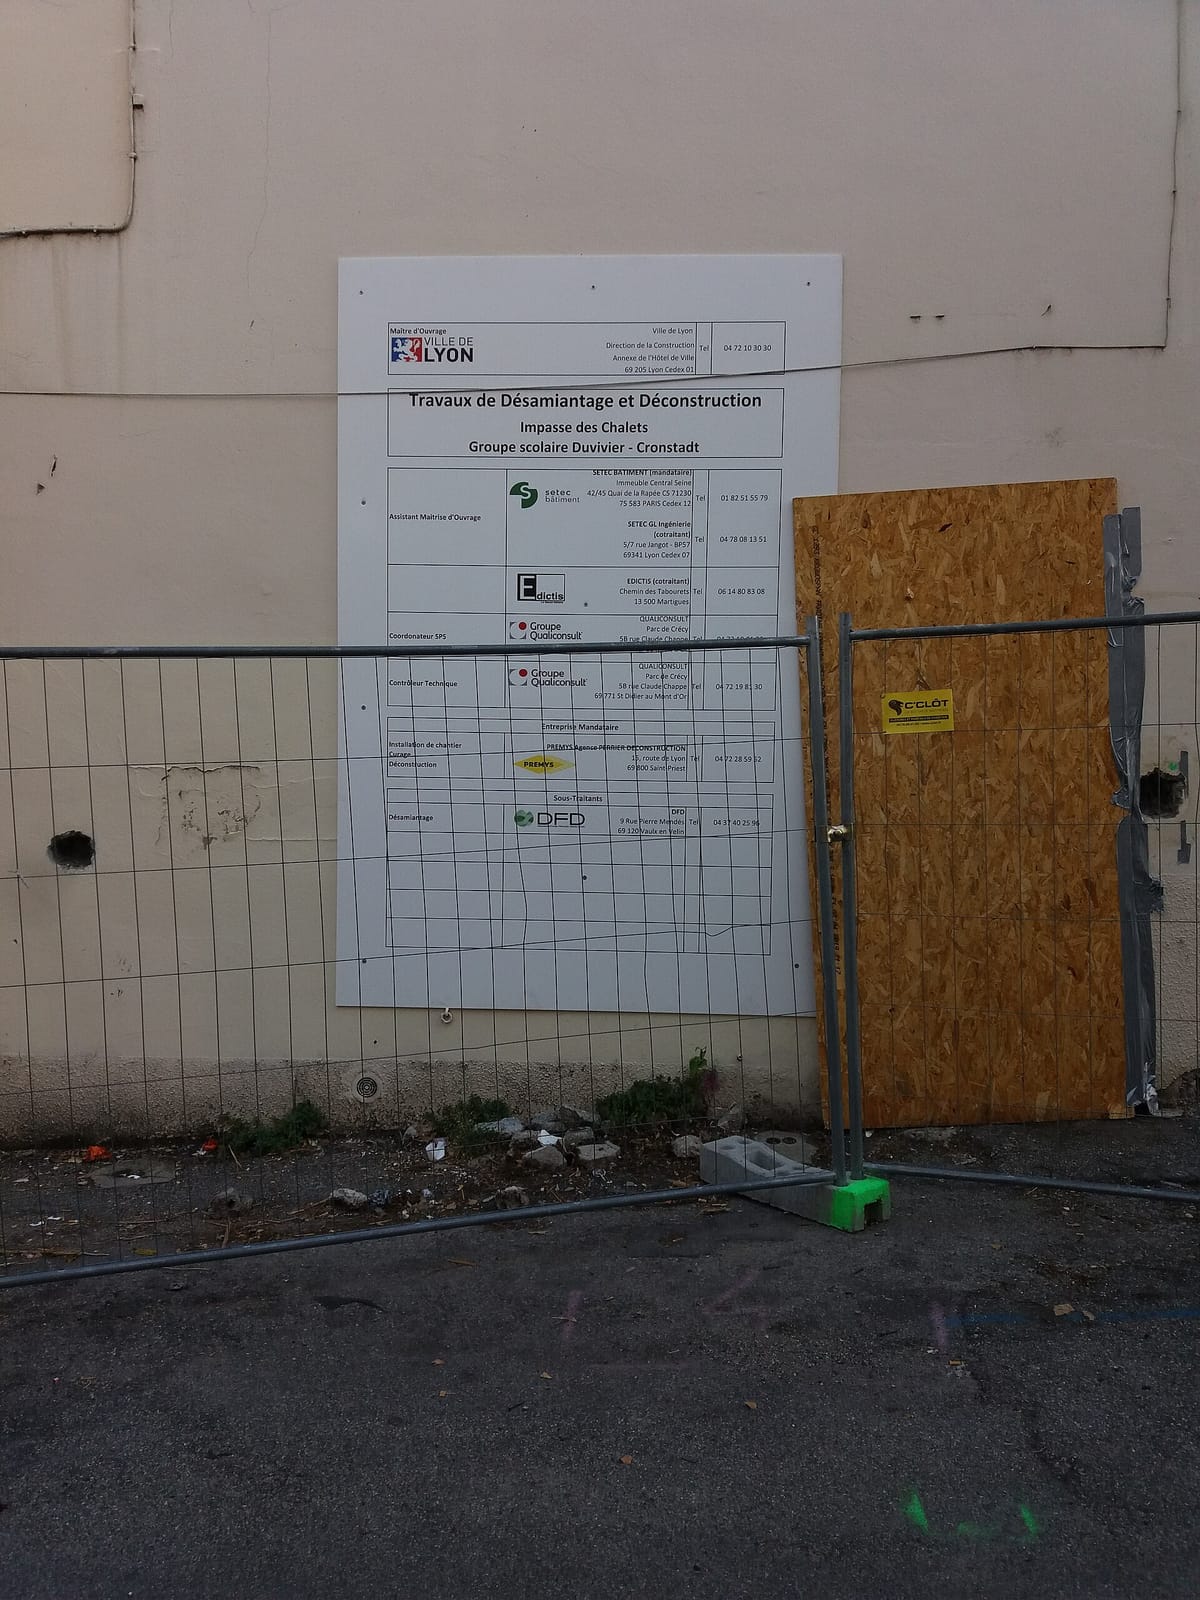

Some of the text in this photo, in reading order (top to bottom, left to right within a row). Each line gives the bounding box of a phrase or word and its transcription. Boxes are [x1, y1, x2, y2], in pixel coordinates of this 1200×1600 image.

[425, 337, 474, 346] VILLE DE
[424, 348, 474, 362] LYON
[410, 392, 762, 410] Travaux de Désamiantage et Déconstruction
[520, 422, 648, 435] Impasse des Chalets
[469, 441, 700, 454] Groupe scolaire Duvivier Cronstadt
[530, 622, 561, 632] Groupe
[530, 631, 582, 641] Qualiconsult
[531, 669, 564, 679] Groupe
[531, 678, 586, 687] Qualiconsult
[537, 813, 585, 825] DFD
